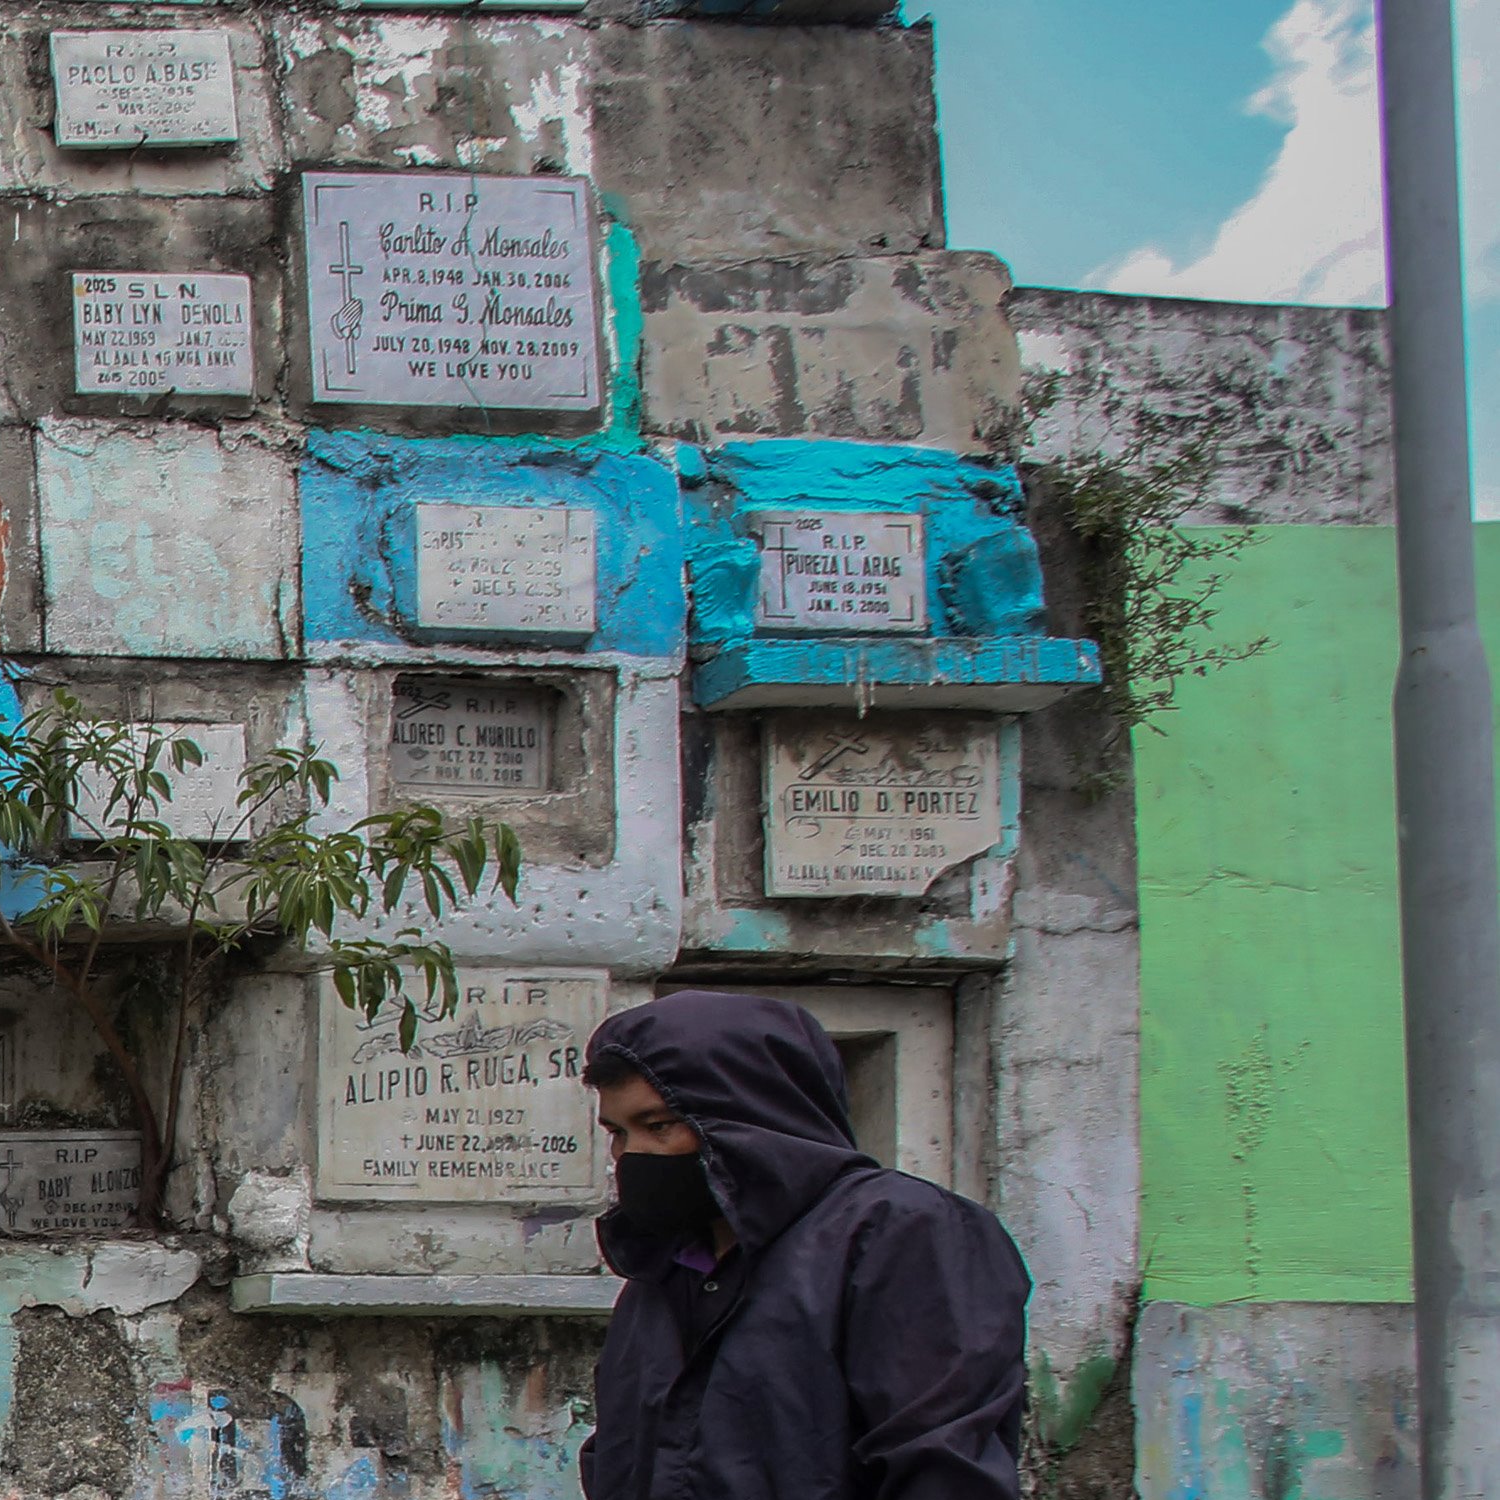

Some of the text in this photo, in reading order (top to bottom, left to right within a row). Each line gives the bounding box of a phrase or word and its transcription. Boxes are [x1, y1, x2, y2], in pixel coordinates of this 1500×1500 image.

[68, 64, 136, 86] PAOLO
[378, 221, 448, 260] Carlito
[478, 226, 571, 260] Monsales
[84, 278, 116, 293] 2025
[83, 303, 243, 325] BABY LYN DENOLA
[379, 291, 443, 325] Prima
[479, 293, 574, 328] Monsales
[81, 331, 107, 346] MAY
[372, 335, 406, 353] JULY
[93, 350, 150, 367] ALAALA
[175, 350, 202, 368] MGA
[207, 351, 237, 367] ANAK
[408, 360, 533, 381] WE LOVE YOU
[785, 552, 839, 577] PUREZA
[807, 580, 838, 595] JUNE
[393, 722, 446, 746] ALDRED
[476, 725, 537, 749] MURILLO
[493, 769, 523, 783] 2015
[792, 789, 861, 813] EMILIO
[904, 791, 979, 815] PORTEZ
[344, 1065, 428, 1107] ALIPIO
[440, 1063, 460, 1094] R.
[425, 1108, 460, 1126] MAY
[415, 1133, 455, 1152] JUNE
[363, 1159, 561, 1179] FAMILY REMEMBRANCE
[38, 1176, 73, 1200] BABY
[31, 1217, 50, 1228] WE
[54, 1217, 87, 1229] LOVE
